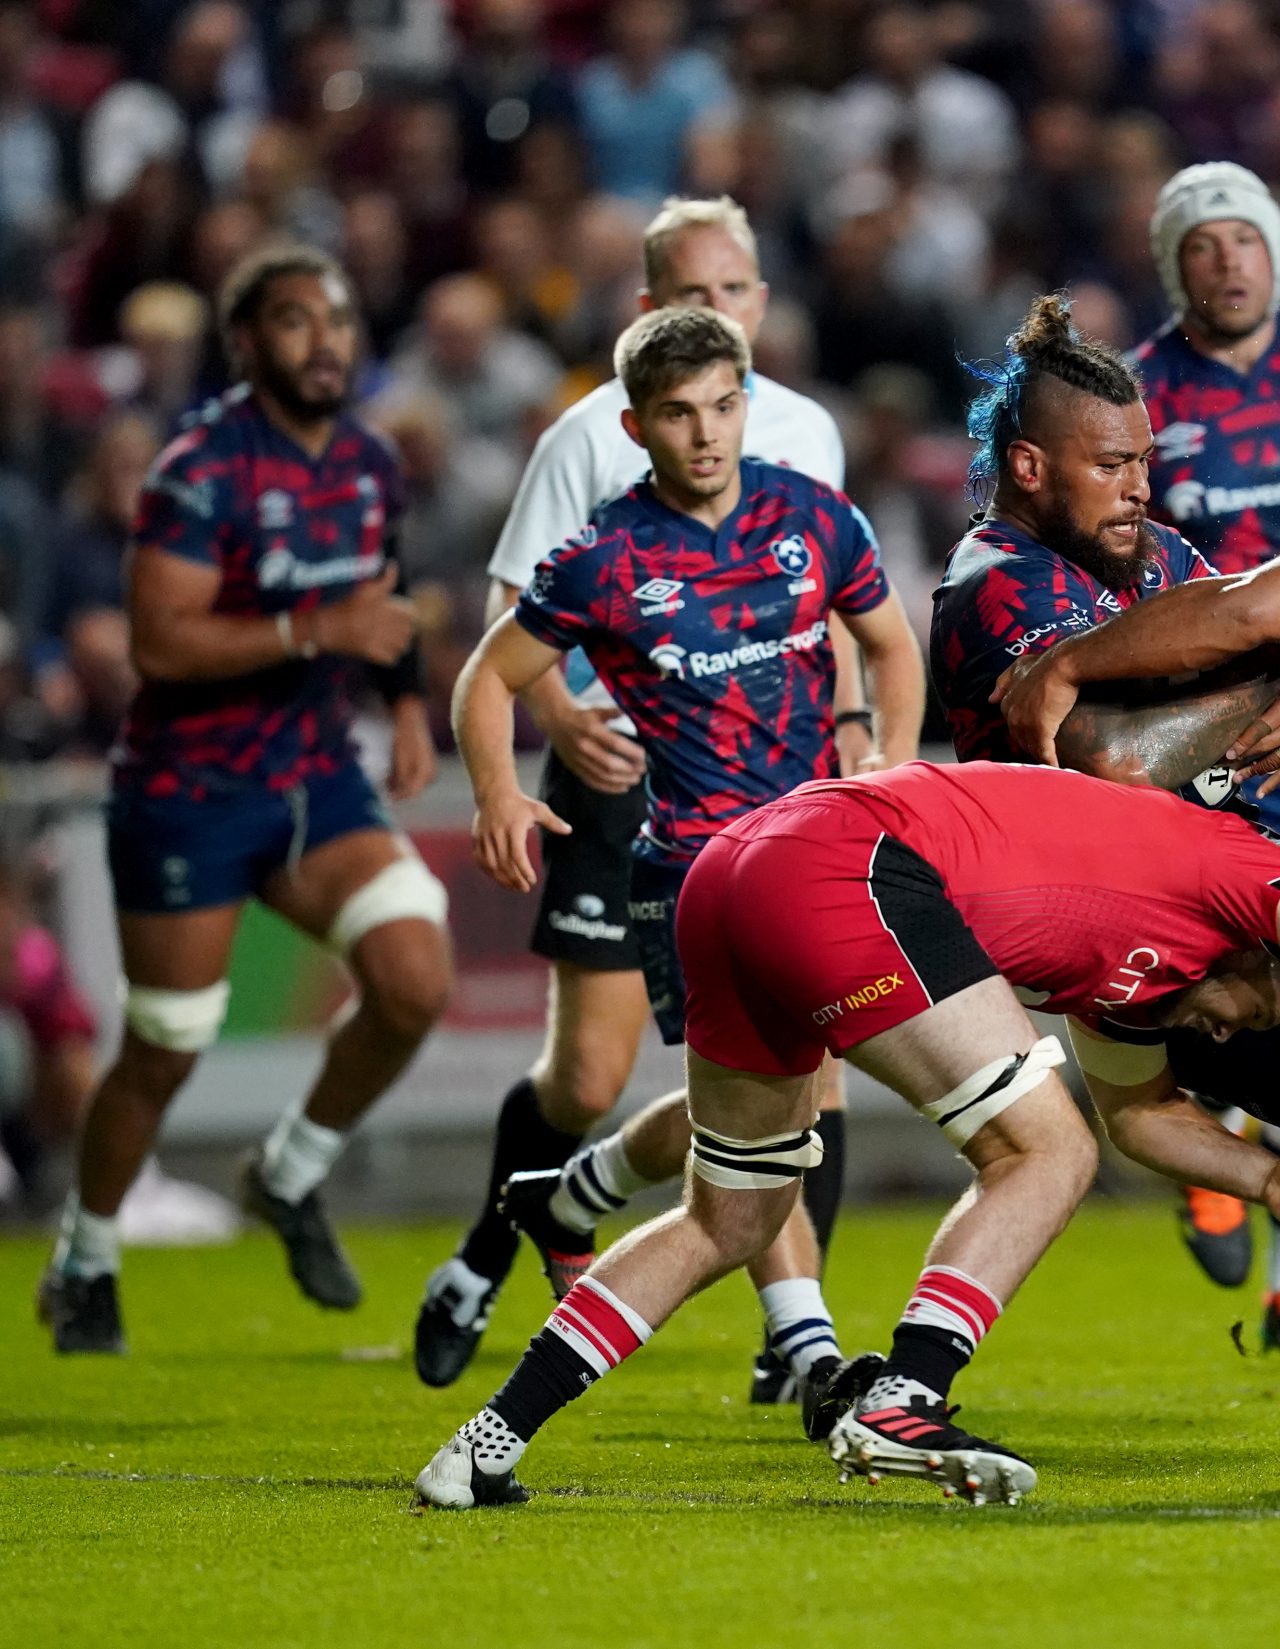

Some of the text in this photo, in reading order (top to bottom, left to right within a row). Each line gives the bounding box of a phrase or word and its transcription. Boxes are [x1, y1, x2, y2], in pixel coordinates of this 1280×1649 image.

[640, 599, 686, 617] umbro
[812, 972, 904, 1025] CITY INDEX
[1094, 947, 1159, 1011] CITY
